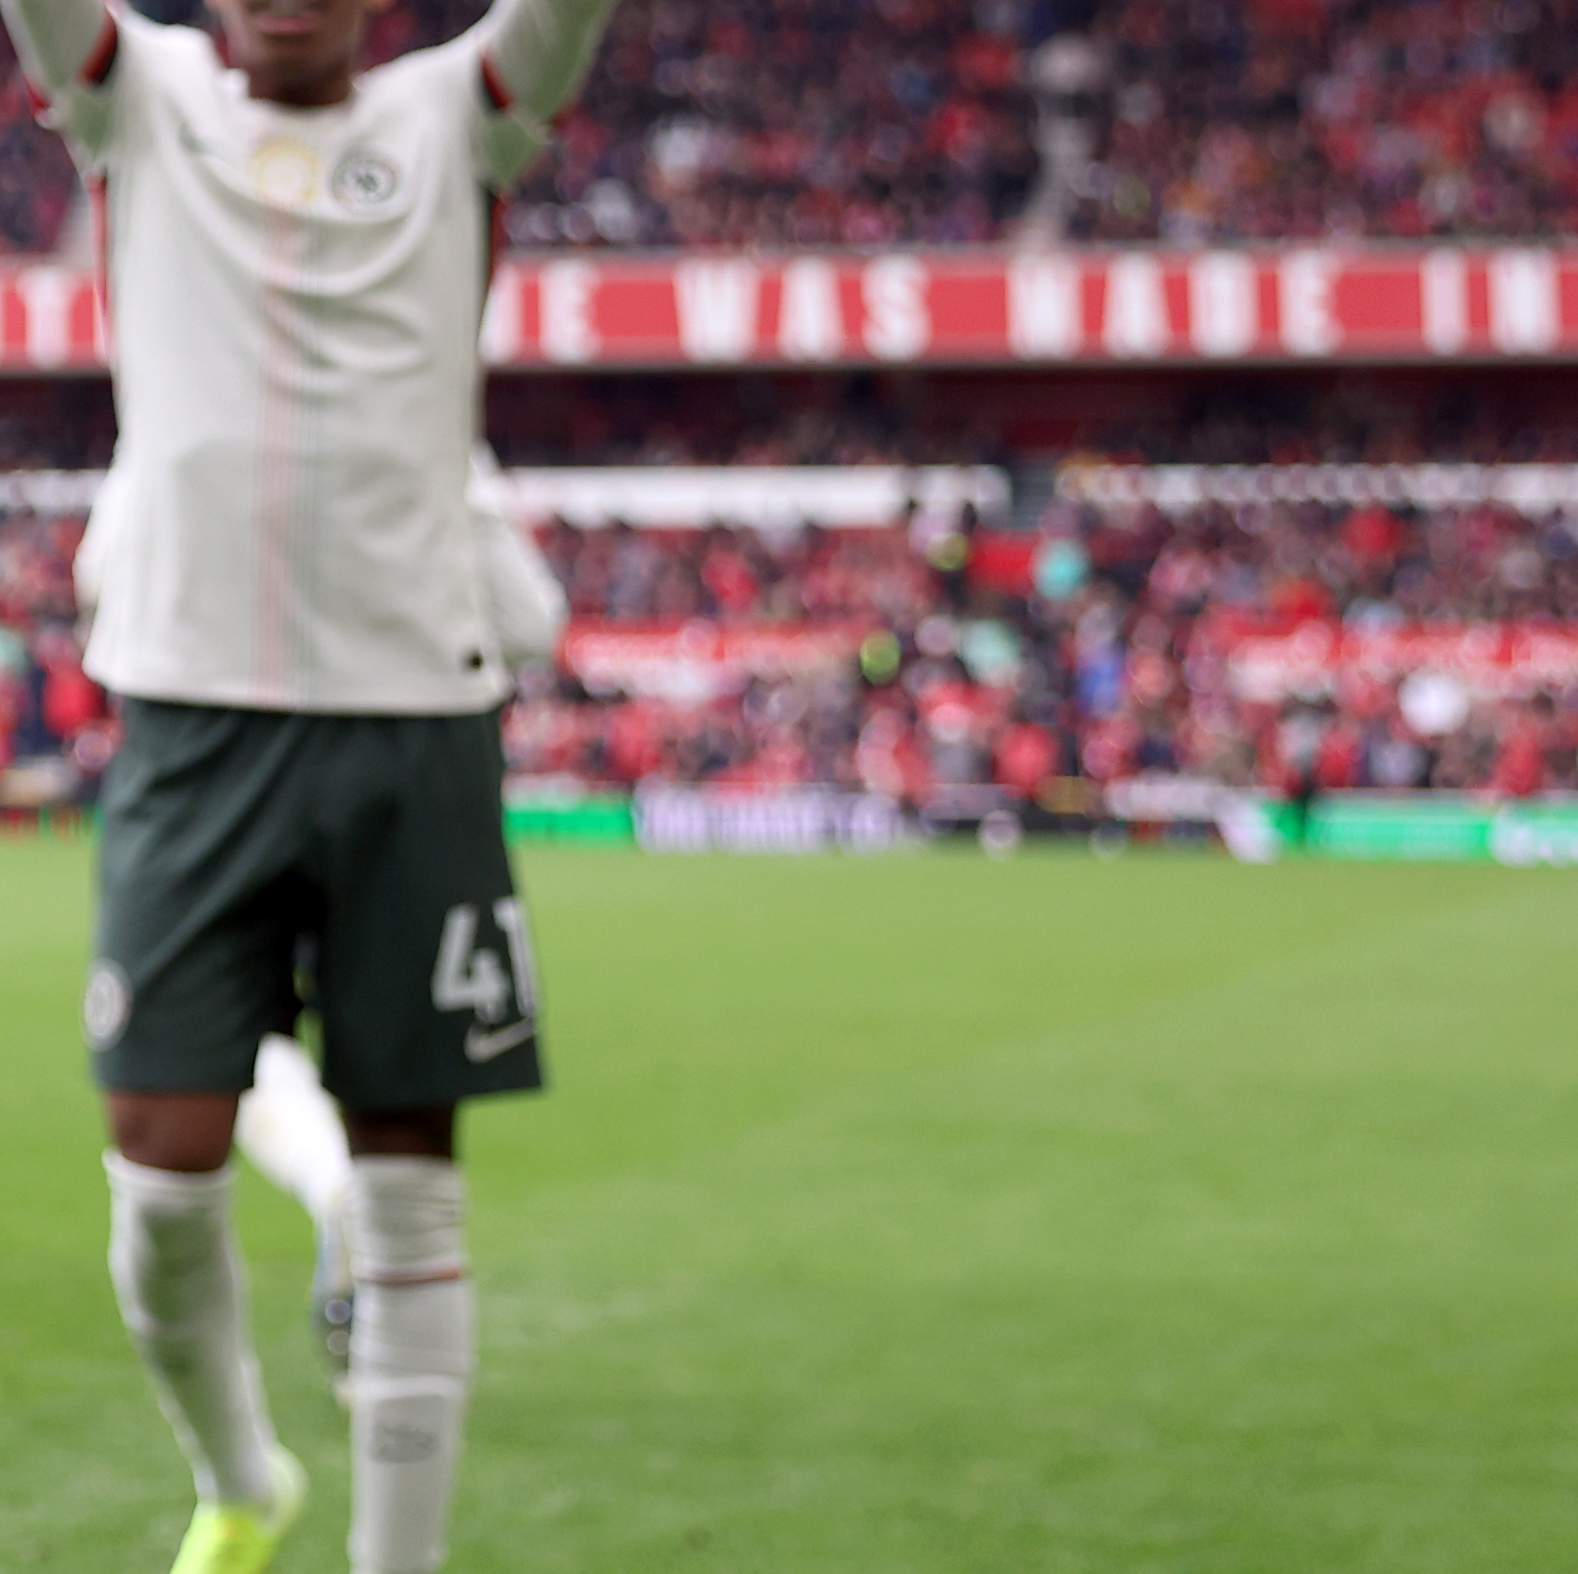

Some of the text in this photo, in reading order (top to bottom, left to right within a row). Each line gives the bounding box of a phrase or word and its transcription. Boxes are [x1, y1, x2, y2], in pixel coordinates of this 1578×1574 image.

[672, 253, 932, 363] WAS
[1420, 245, 1562, 360] IN
[431, 896, 537, 1024] 41
